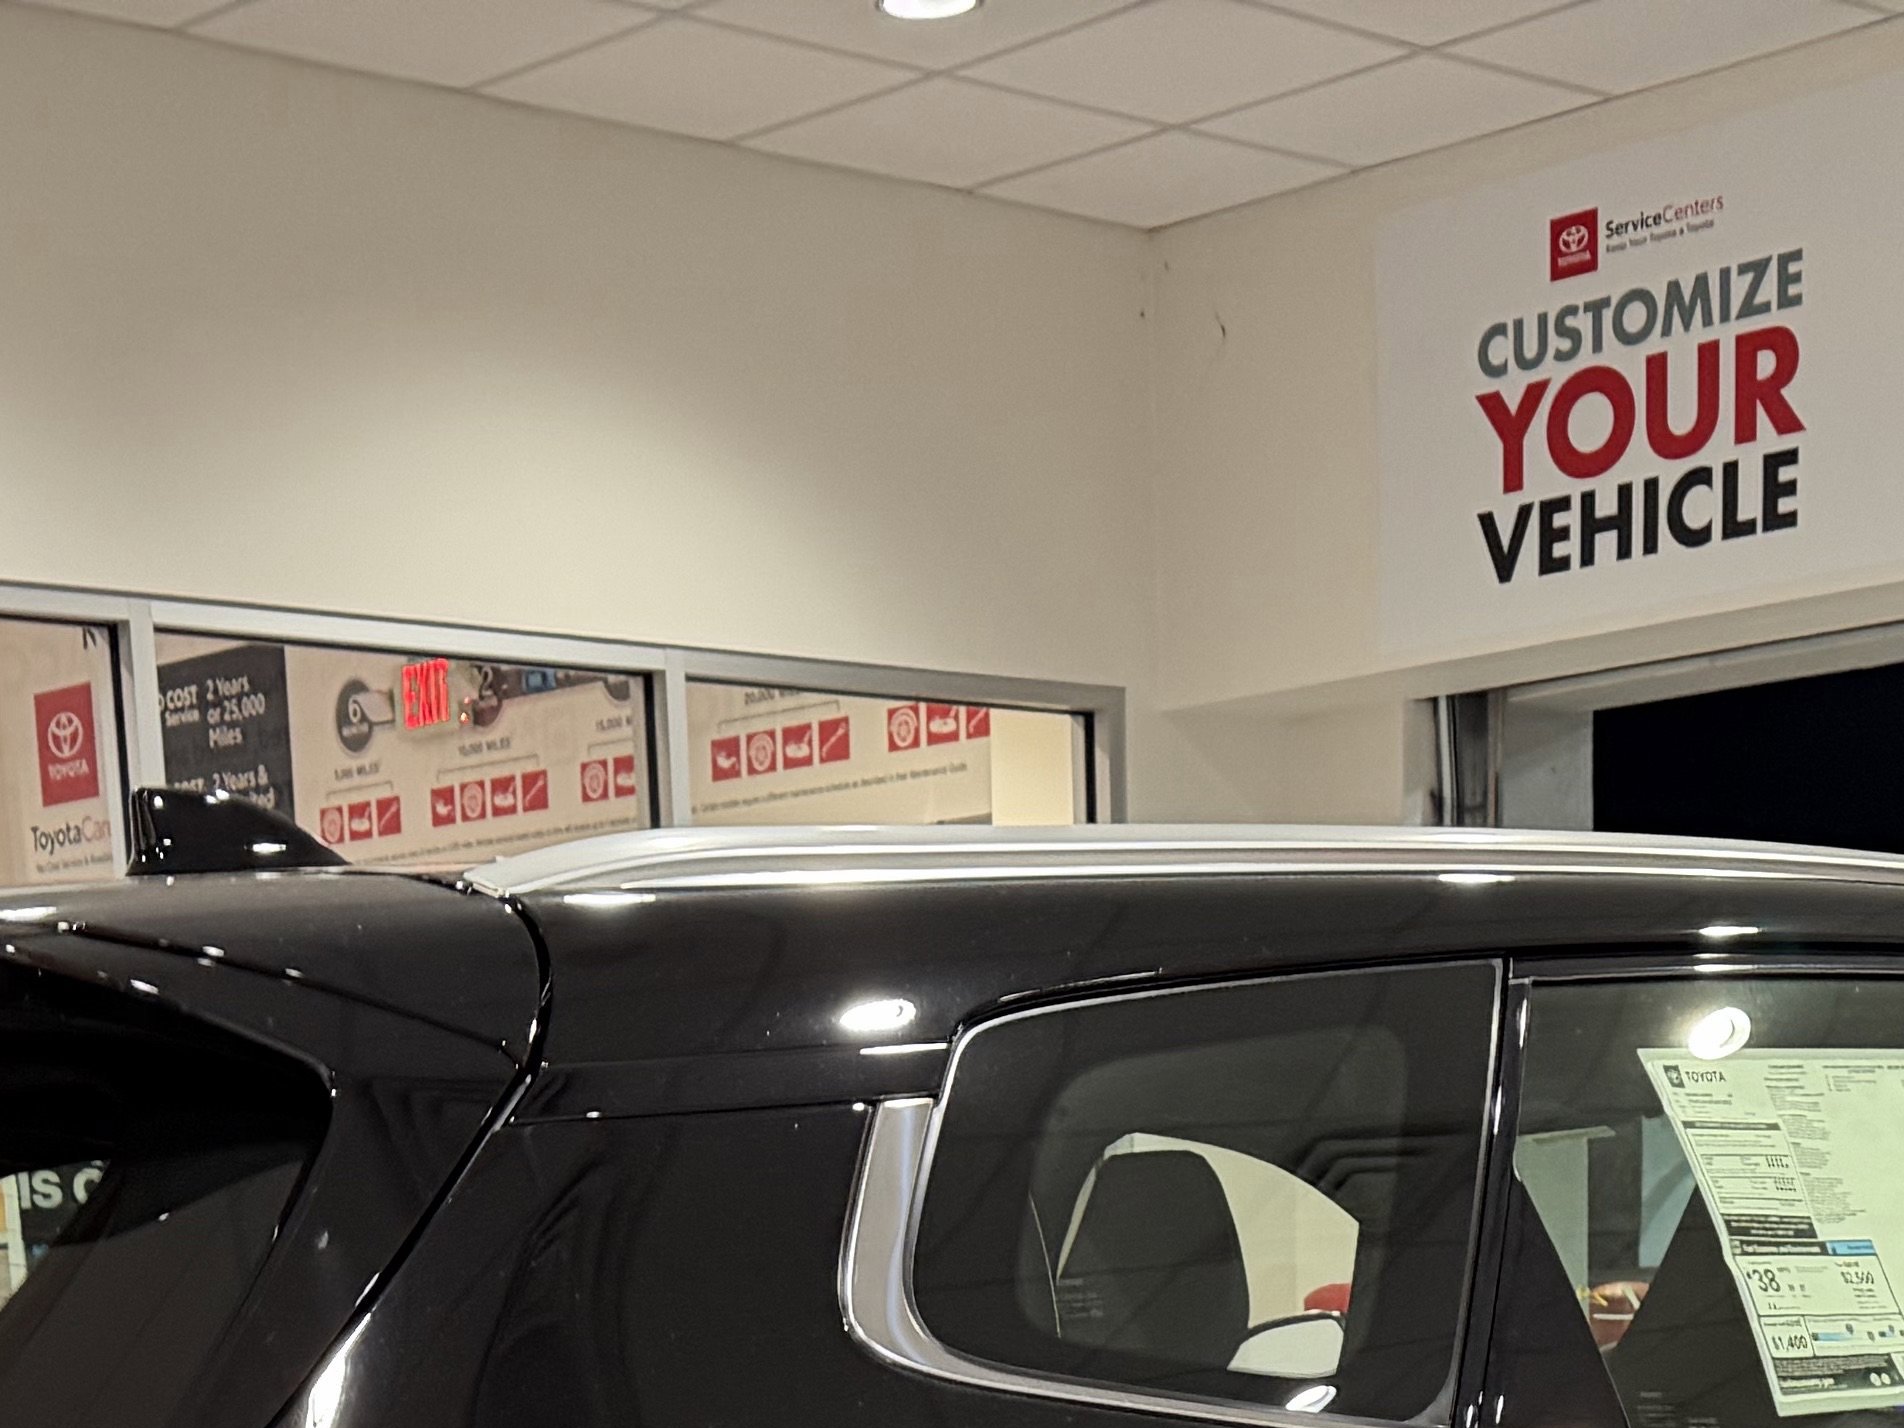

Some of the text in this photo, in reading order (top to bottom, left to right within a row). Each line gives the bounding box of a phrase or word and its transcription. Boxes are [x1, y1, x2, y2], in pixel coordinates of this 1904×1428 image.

[1605, 196, 1724, 239] ServiceCenters
[1477, 248, 1803, 378] CUSTOMIZE
[1475, 326, 1806, 495] YOUR
[1477, 446, 1799, 584] VEHICLE
[166, 684, 198, 710] COST
[206, 678, 214, 701] 2
[402, 657, 450, 729] EXIT
[30, 816, 112, 857] ToyotaCar
[1684, 1070, 1727, 1083] TOYOTA
